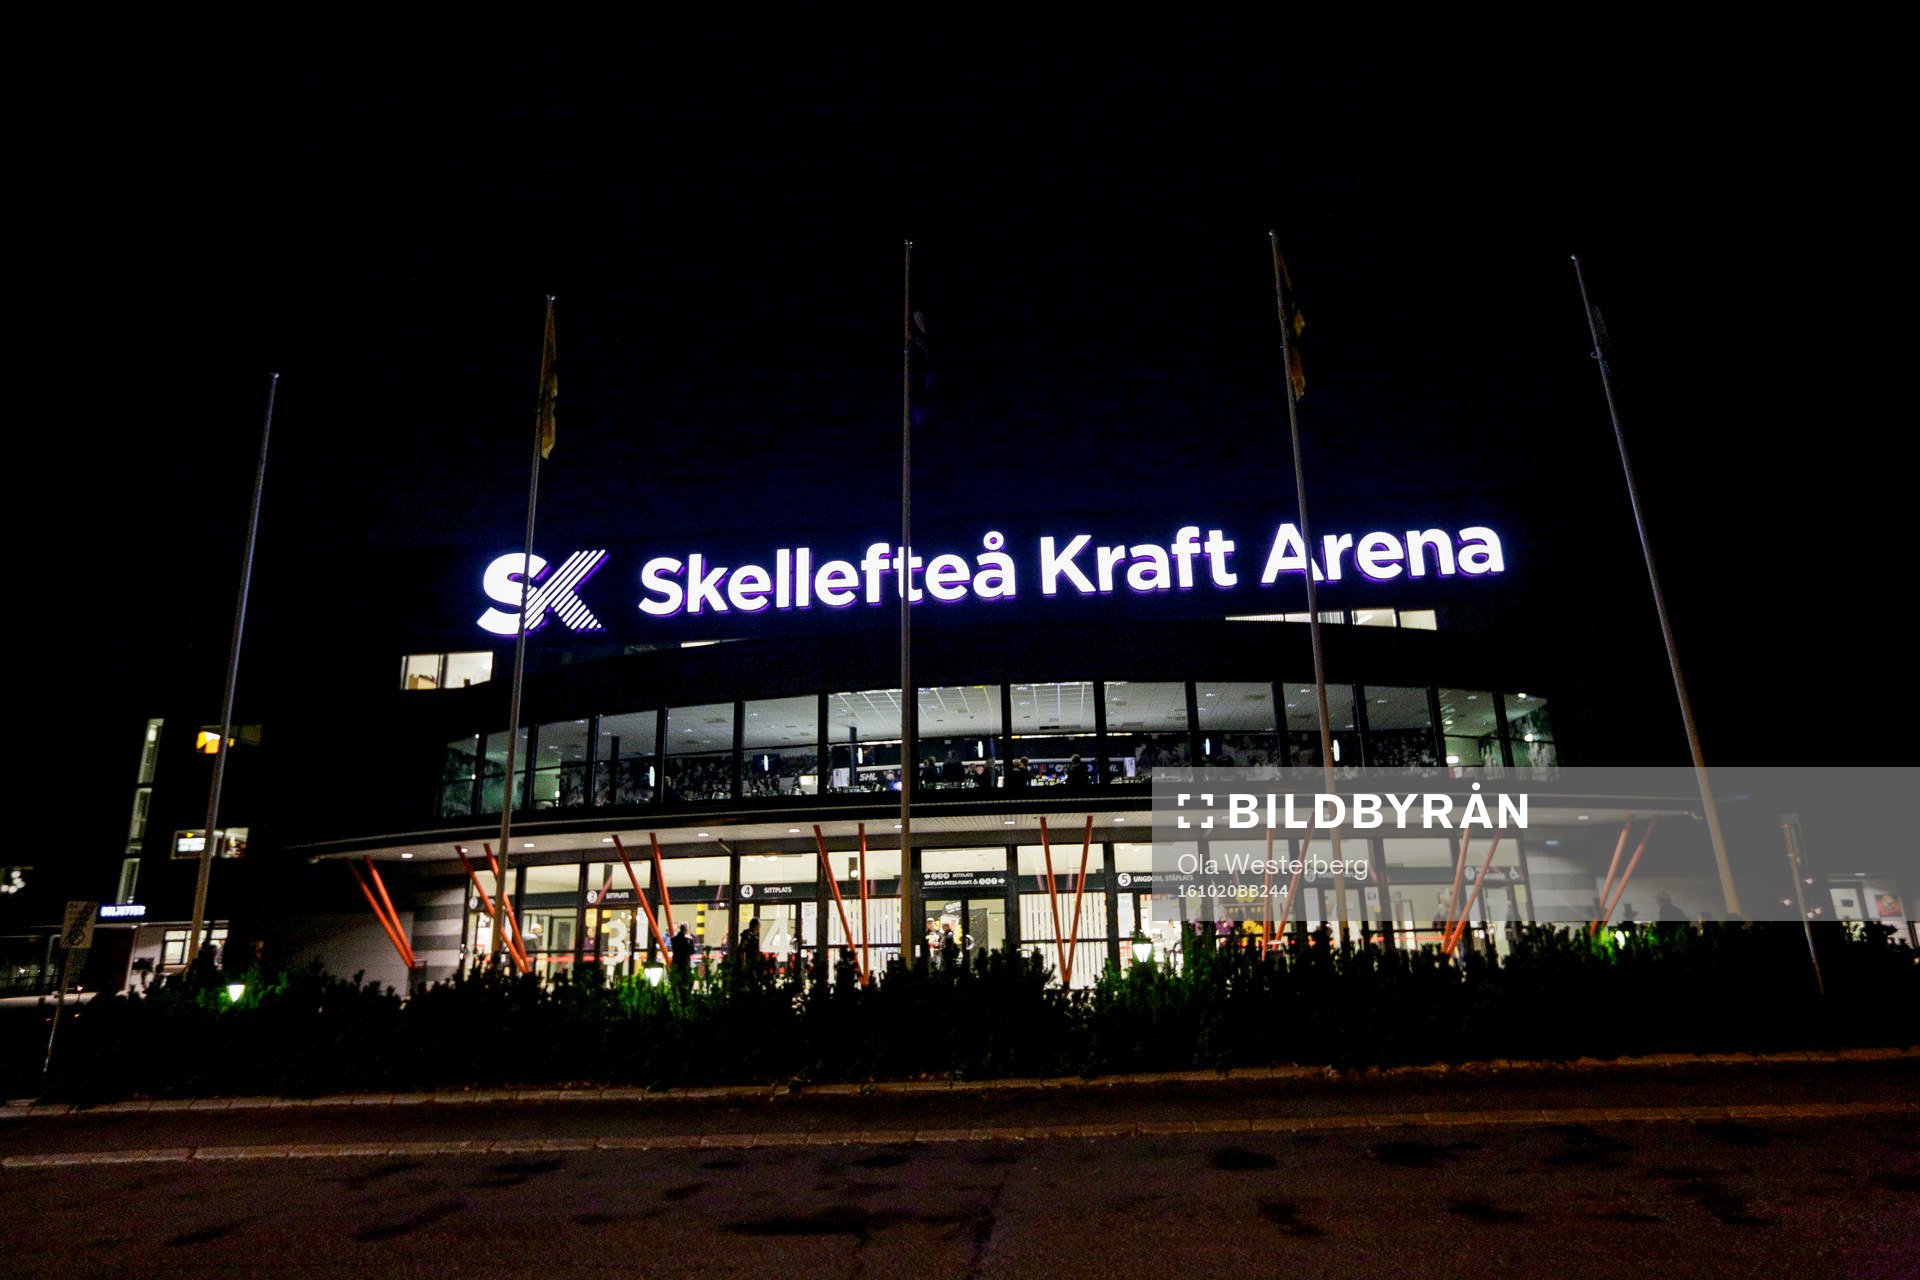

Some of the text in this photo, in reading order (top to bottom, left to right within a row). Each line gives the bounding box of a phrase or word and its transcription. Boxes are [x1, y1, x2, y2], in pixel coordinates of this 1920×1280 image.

[476, 549, 606, 636] SK
[638, 523, 1505, 615] Skellefteå Kraft Arena
[763, 886, 793, 894] SITTPLATS
